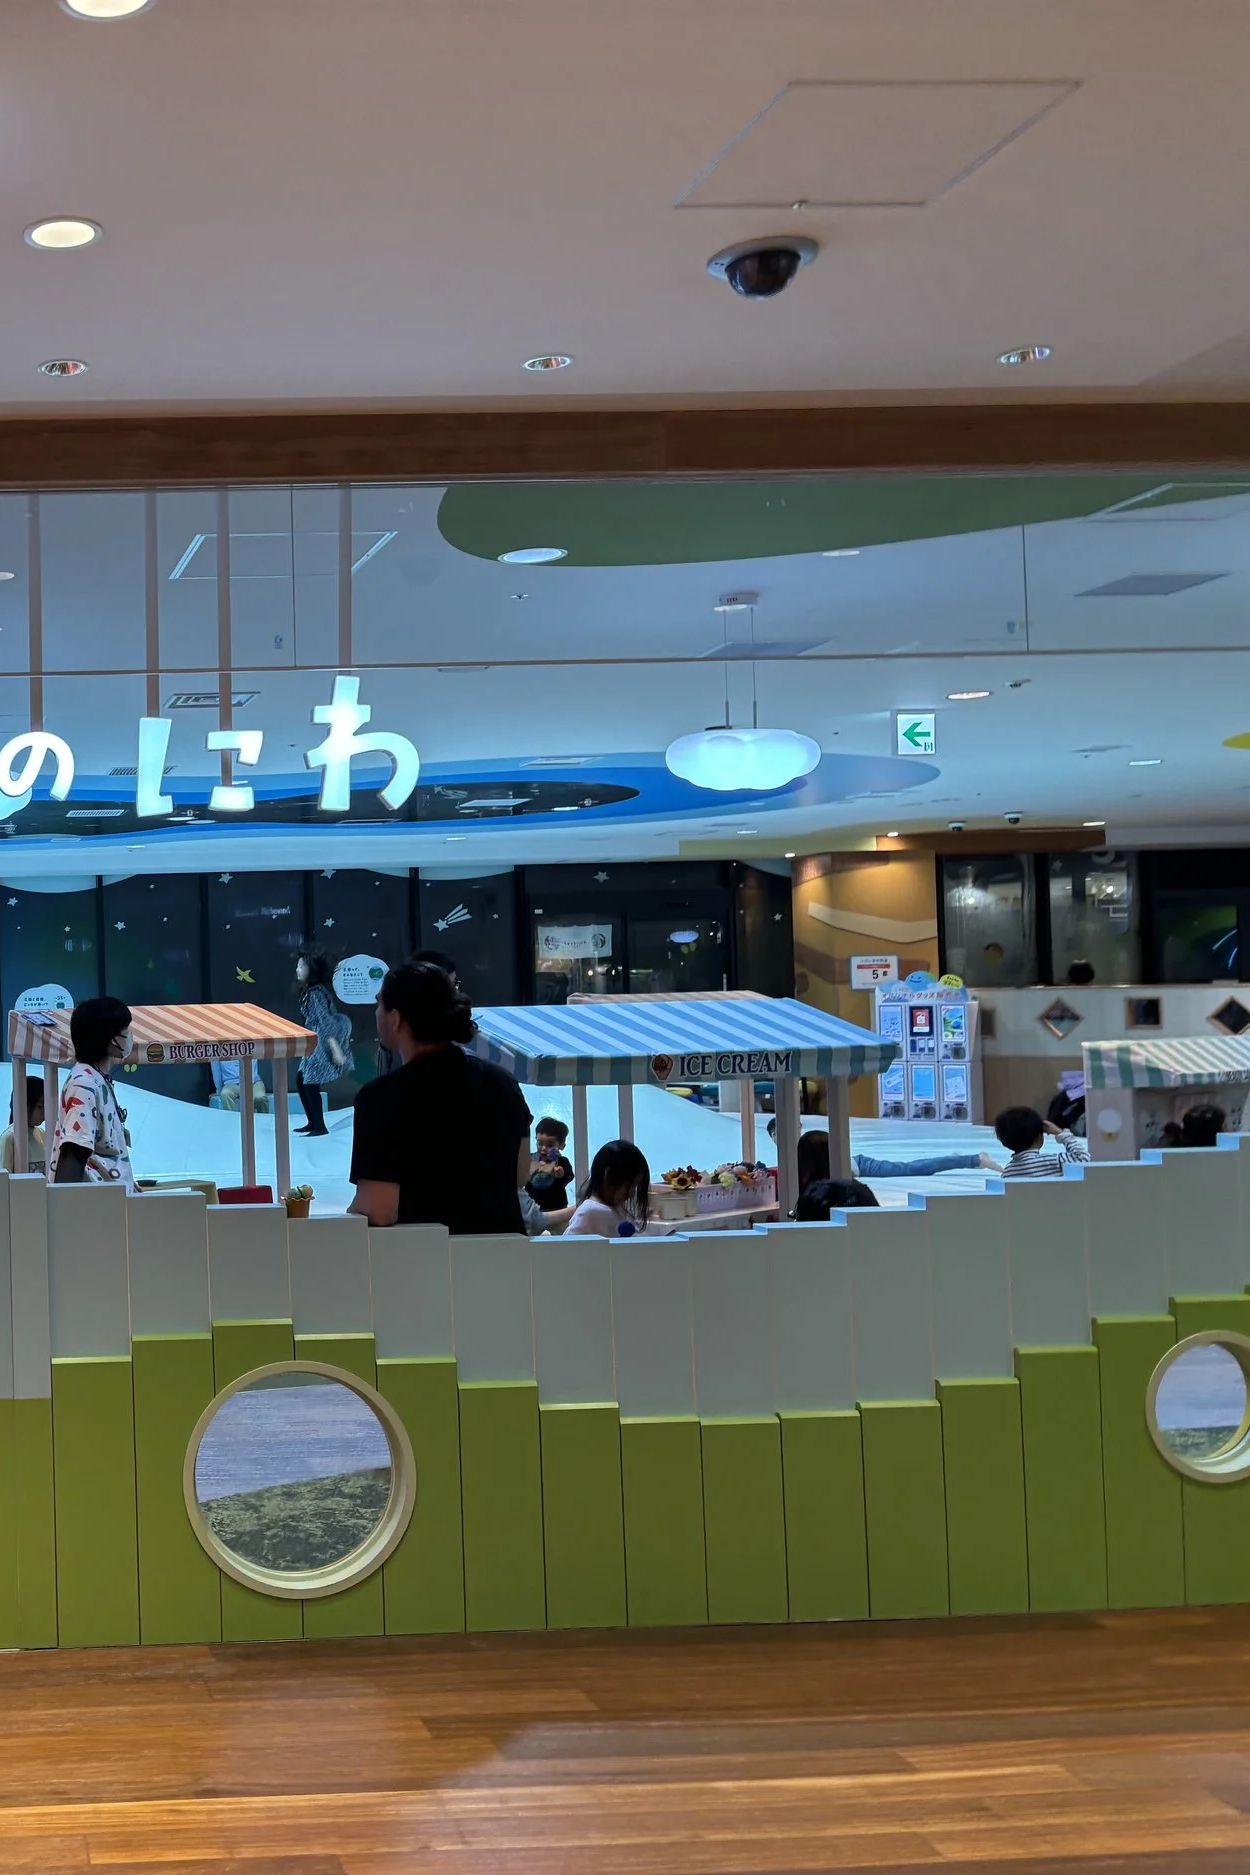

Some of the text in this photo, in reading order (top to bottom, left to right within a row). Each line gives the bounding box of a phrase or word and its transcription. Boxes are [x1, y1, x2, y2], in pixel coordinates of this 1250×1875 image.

[169, 1041, 255, 1059] BURGER SHOP
[679, 1051, 792, 1077] ICE CREAM
